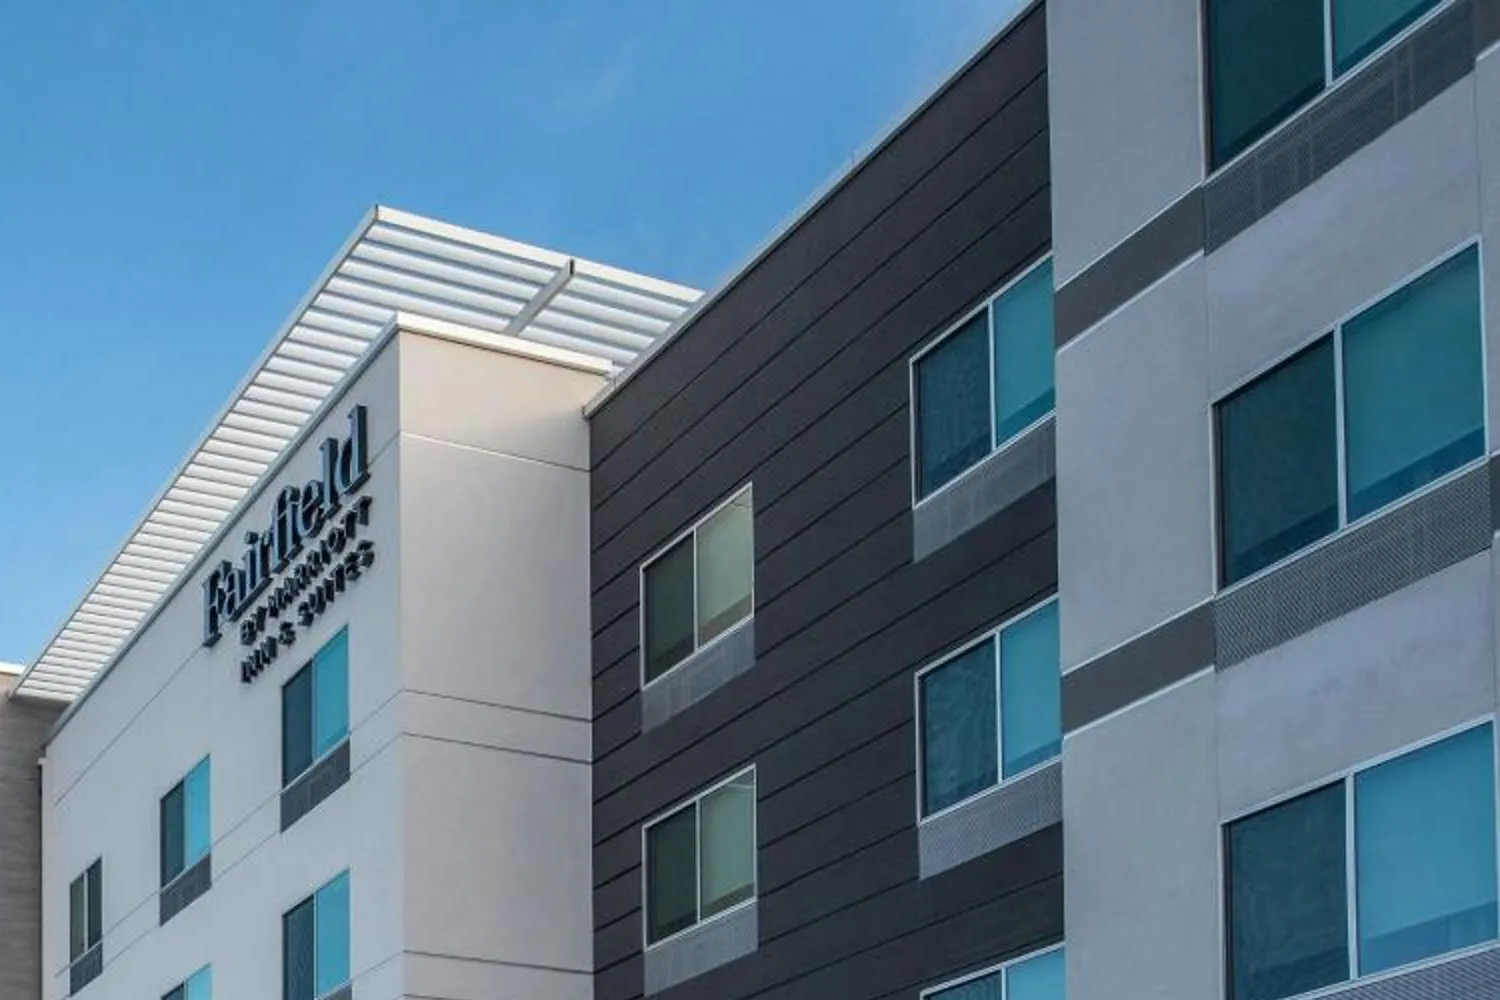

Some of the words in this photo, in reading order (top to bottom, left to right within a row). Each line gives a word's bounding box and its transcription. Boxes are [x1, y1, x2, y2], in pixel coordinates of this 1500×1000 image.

[201, 404, 371, 648] Fairfield
[240, 605, 267, 645] BY
[268, 496, 372, 618] MARRIOTT
[240, 635, 278, 684] INN
[297, 539, 375, 627] SUITES
